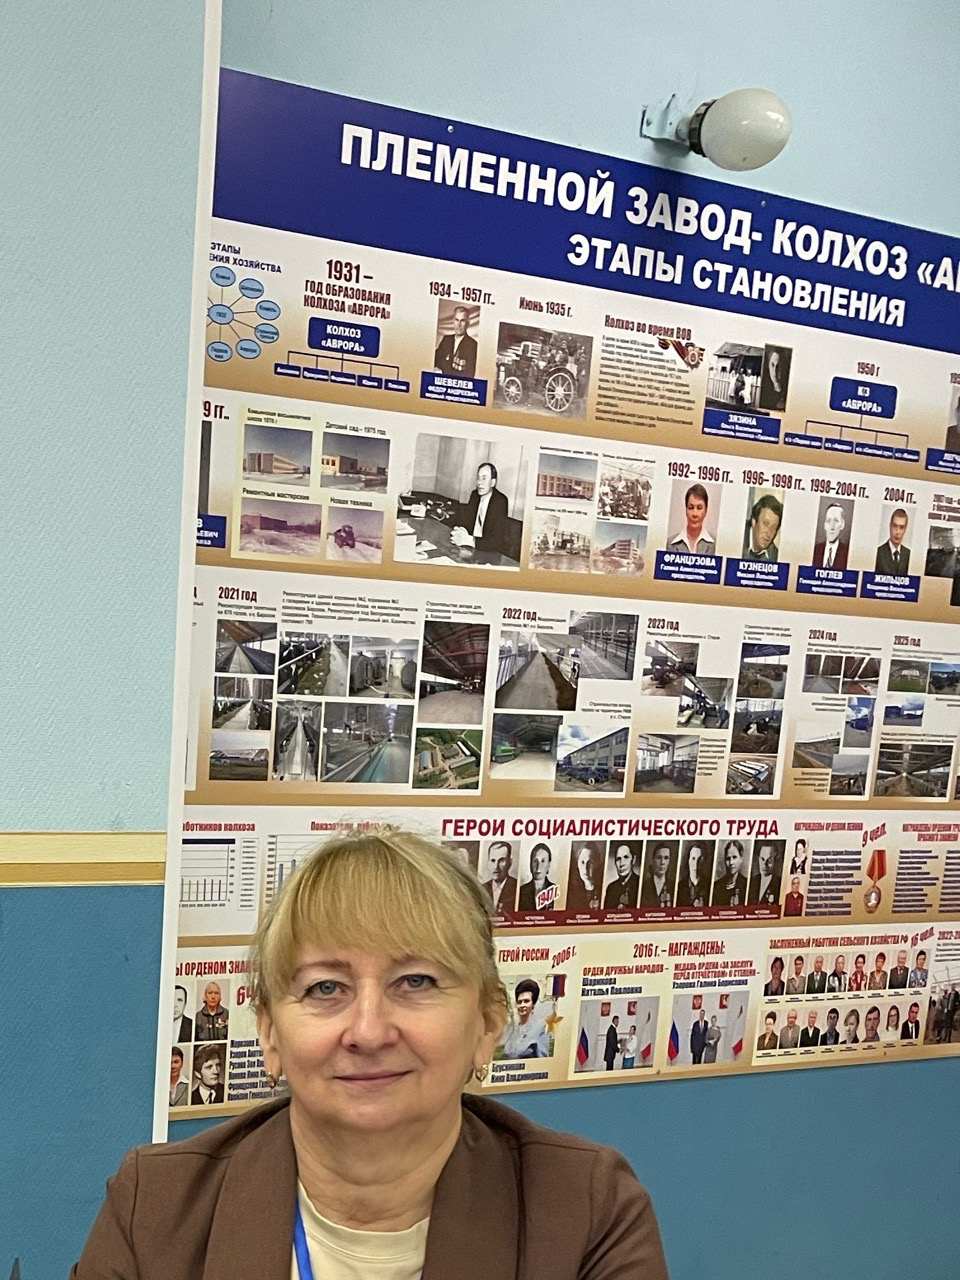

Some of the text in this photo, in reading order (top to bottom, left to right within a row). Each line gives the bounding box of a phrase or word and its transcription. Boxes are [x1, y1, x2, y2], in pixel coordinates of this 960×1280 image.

[340, 124, 614, 219] ПЛЕМЕННОЙ
[772, 218, 910, 282] КОЛХОЗ
[210, 242, 240, 254] ЭТАПЫ
[232, 256, 282, 274] ХОЗЯЙСТВА
[326, 259, 361, 284] 1931
[567, 233, 907, 328] ЭТАПЫ СТАНОВЛЕНИЯ
[304, 279, 391, 306] ГОД ОБРАЗОВАНИЯ
[429, 281, 482, 303] 1934 1957
[303, 294, 391, 320] КОЛХОЗА «АВРОРА»
[519, 297, 544, 312] Июнь
[546, 302, 566, 317] 1935
[326, 325, 362, 339] КОЛХОЗ
[605, 315, 635, 332] Колхоз
[636, 322, 647, 334] во
[648, 325, 675, 340] время
[321, 338, 365, 353] «АВРОРА»
[857, 361, 876, 376] 1950
[434, 377, 473, 390] ШЕВЕЛЕВ
[842, 399, 882, 413] «АВРОРА»
[698, 465, 721, 482] 1996
[771, 473, 793, 489] 1998
[243, 487, 276, 497] Ремонтные
[884, 487, 905, 501] 2004
[664, 554, 716, 567] ФРАНЦУЗОВА
[739, 561, 779, 573] КУЗНЕЦОВ
[815, 569, 843, 580] ГОГЛЕВ
[874, 574, 910, 586] ЖИЛЬЦОВ
[218, 586, 257, 603] 2021 год
[502, 607, 537, 622] 2022 год
[647, 617, 679, 632] 2023 год
[808, 629, 837, 642] 2024 год
[224, 822, 255, 832] колхоза
[441, 818, 779, 840] ГЕРОИ СОЦИАЛИСТИЧЕСКОГО ТРУДА
[499, 947, 550, 962] ГЕРОЙ РОССИИ
[633, 944, 653, 958] 2016
[668, 941, 725, 958] НАГРАЖДЕНЫ:
[184, 961, 227, 977] ОРДЕНОМ
[583, 966, 604, 977] ОРДЕН
